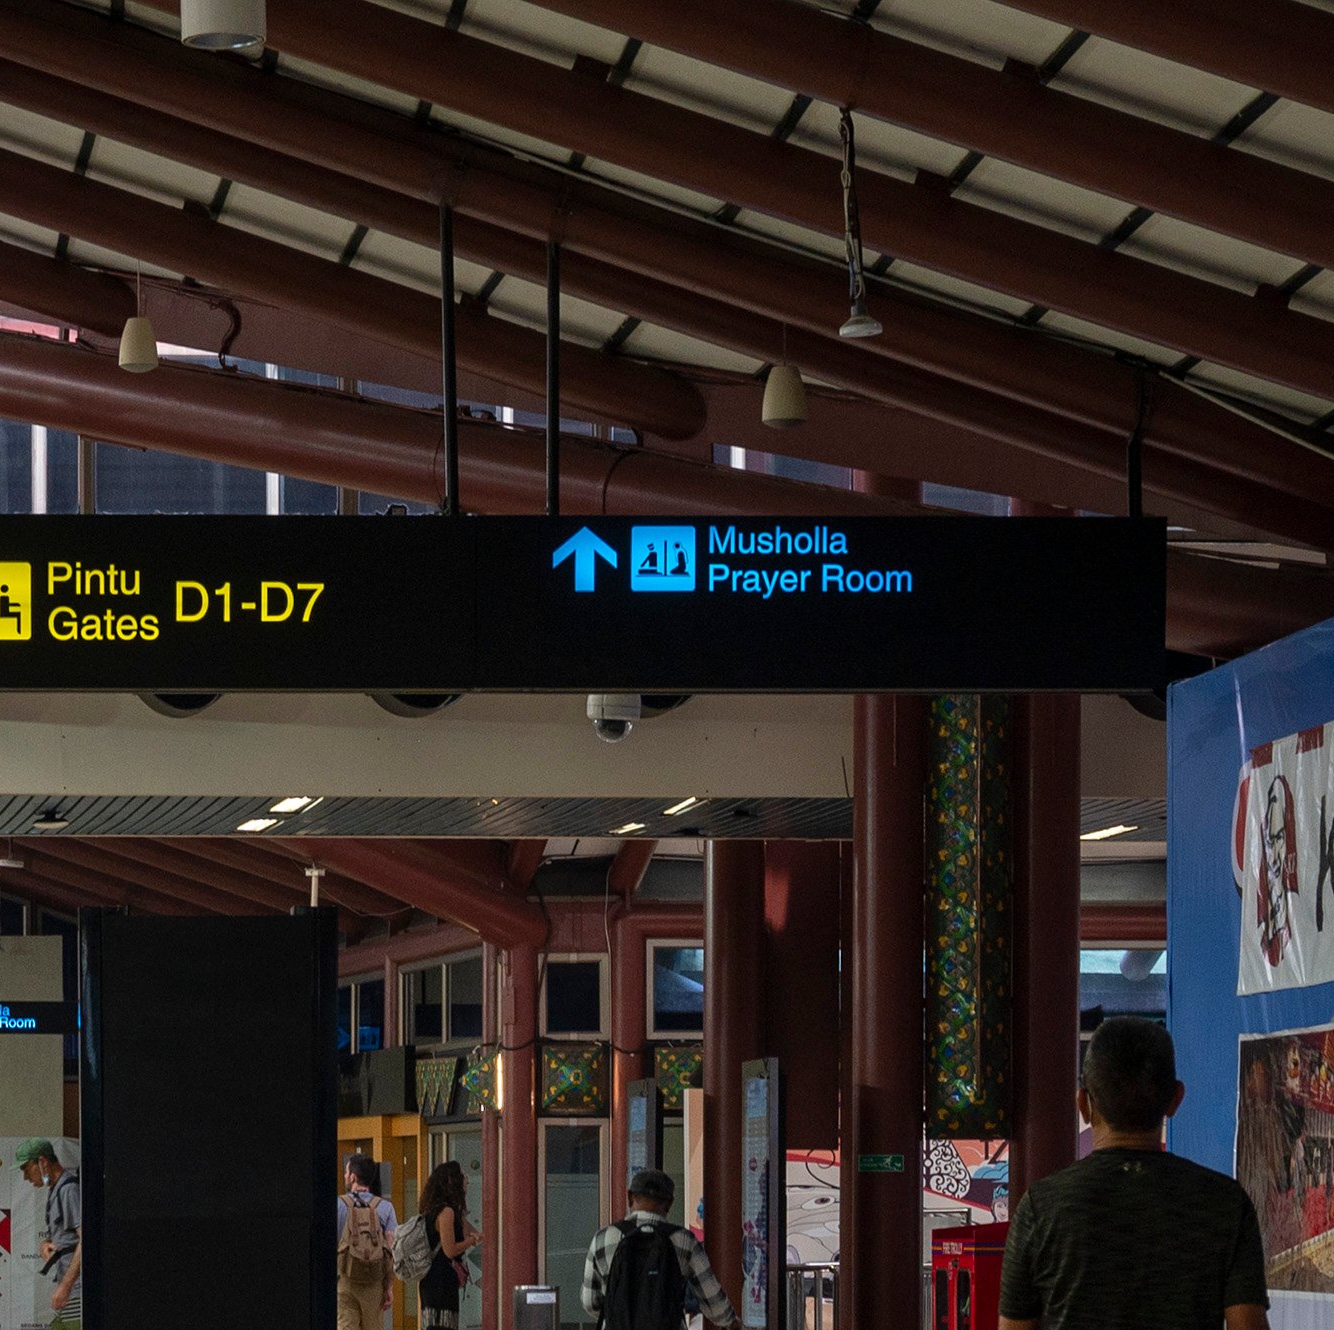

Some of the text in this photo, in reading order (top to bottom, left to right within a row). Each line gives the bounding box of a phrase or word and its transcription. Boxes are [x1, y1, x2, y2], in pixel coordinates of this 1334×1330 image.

[709, 525, 849, 556] Musholla
[47, 562, 142, 597] Pintu
[709, 562, 913, 600] Prayer Room
[175, 581, 326, 627] D1-D7
[47, 605, 161, 644] Gates
[0, 1017, 36, 1028] Room
